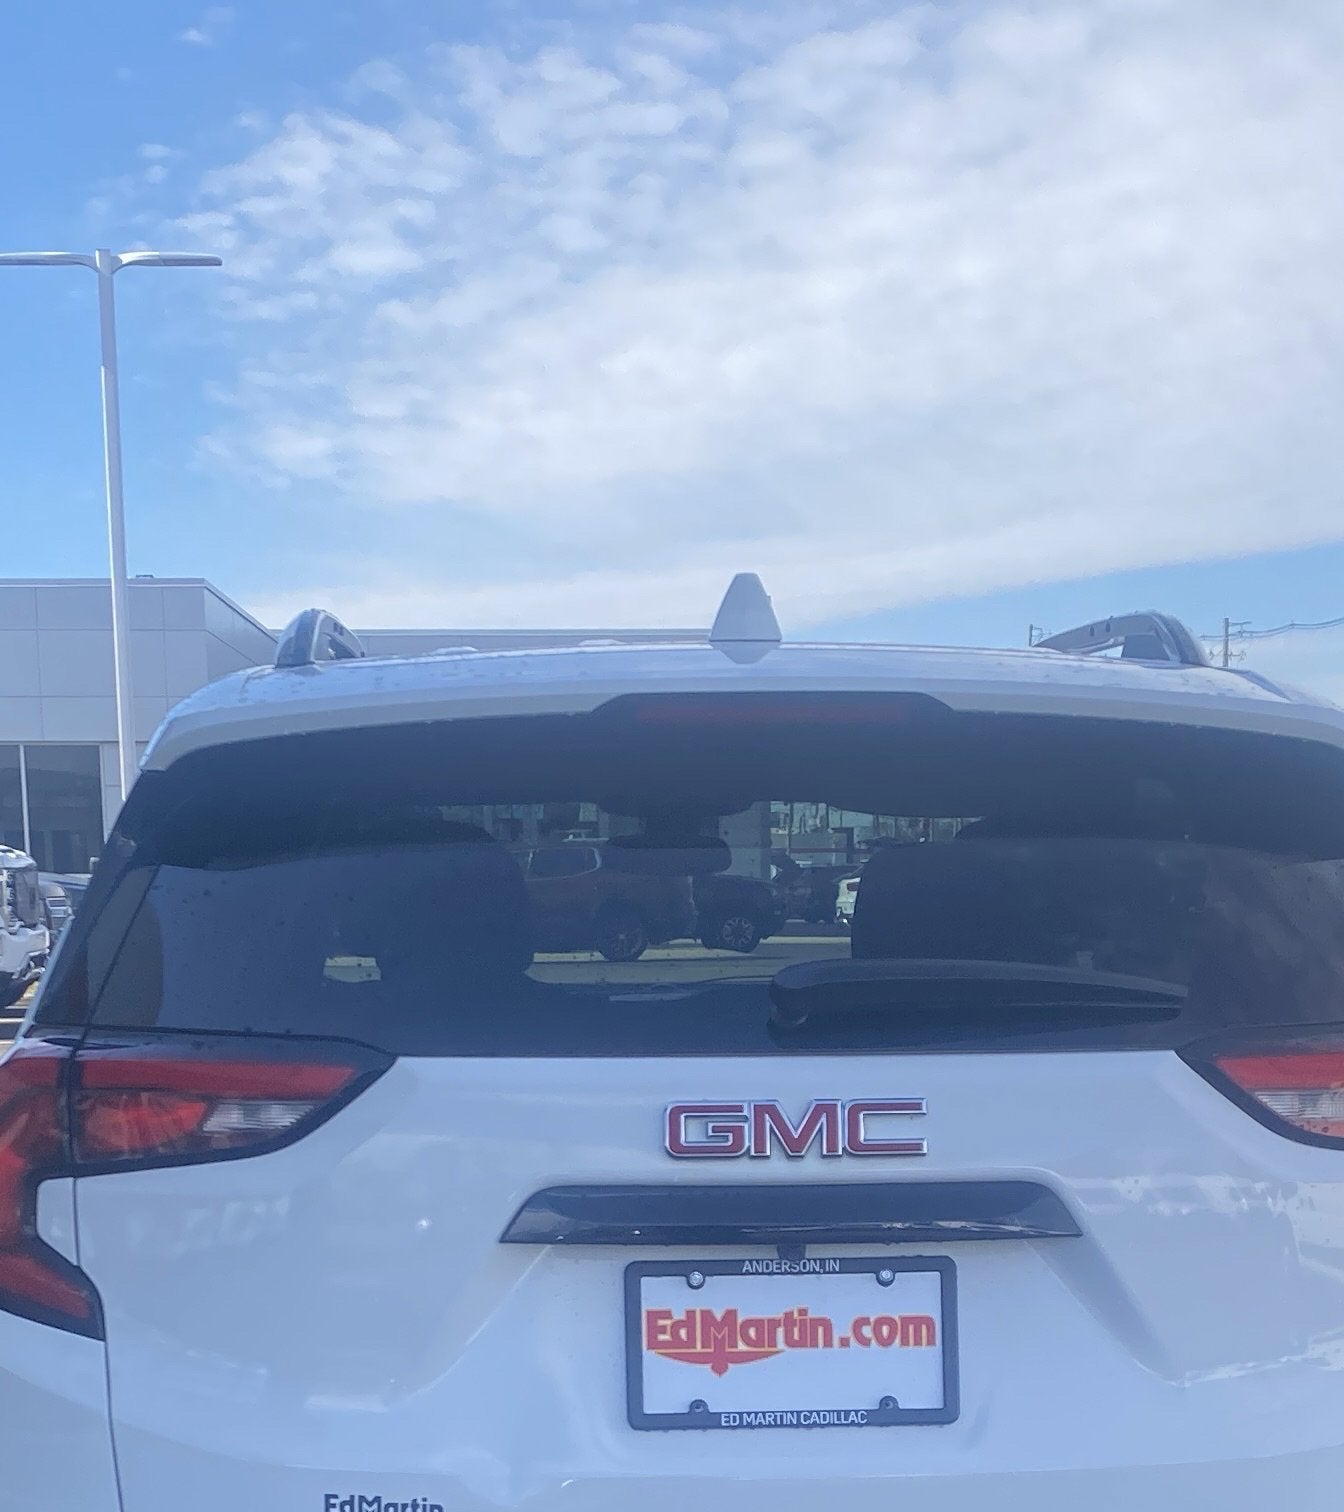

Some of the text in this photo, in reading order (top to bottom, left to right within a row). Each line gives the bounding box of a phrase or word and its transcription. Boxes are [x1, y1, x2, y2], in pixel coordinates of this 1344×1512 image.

[664, 1098, 928, 1157] GMC
[720, 1411, 867, 1426] ED MARTIN CADILLAC
